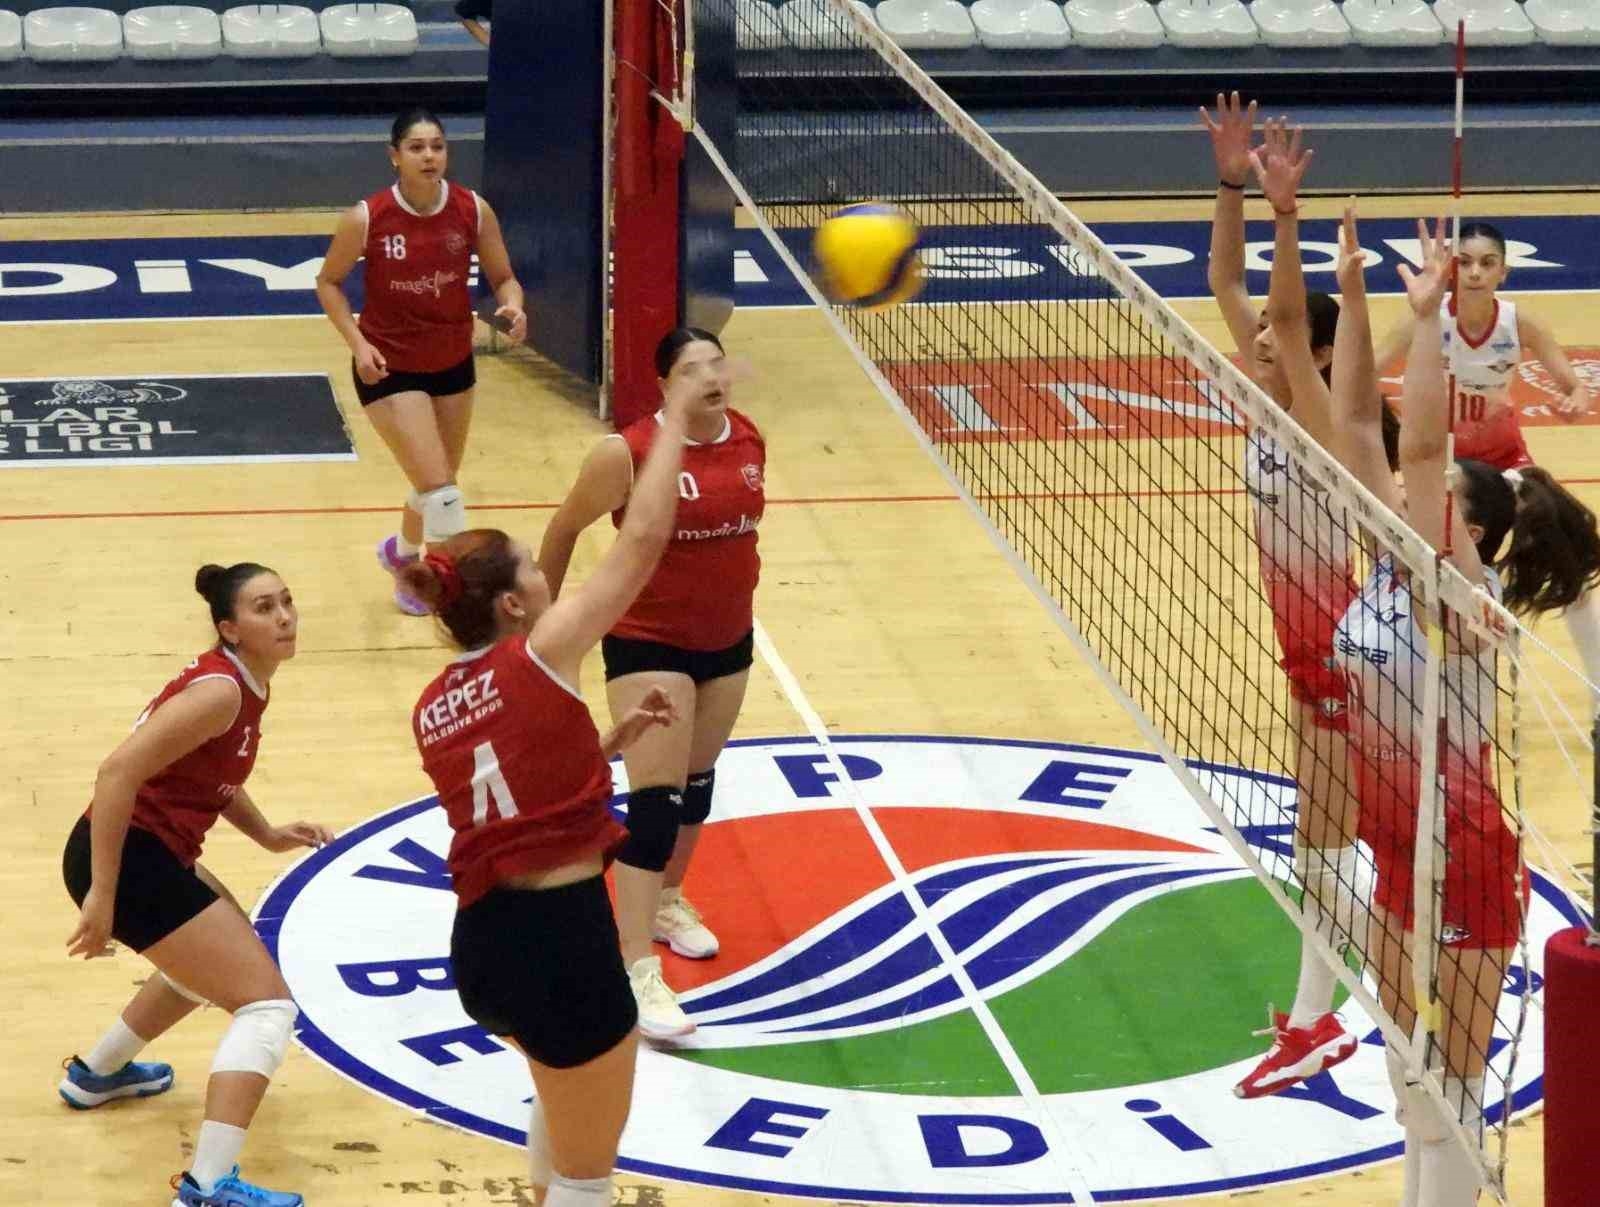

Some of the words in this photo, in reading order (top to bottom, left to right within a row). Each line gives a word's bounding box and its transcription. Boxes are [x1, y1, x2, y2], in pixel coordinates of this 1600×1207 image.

[378, 234, 407, 260] 18
[0, 419, 198, 438] TBOL
[677, 471, 700, 501] 0
[420, 669, 499, 735] KEPEZ
